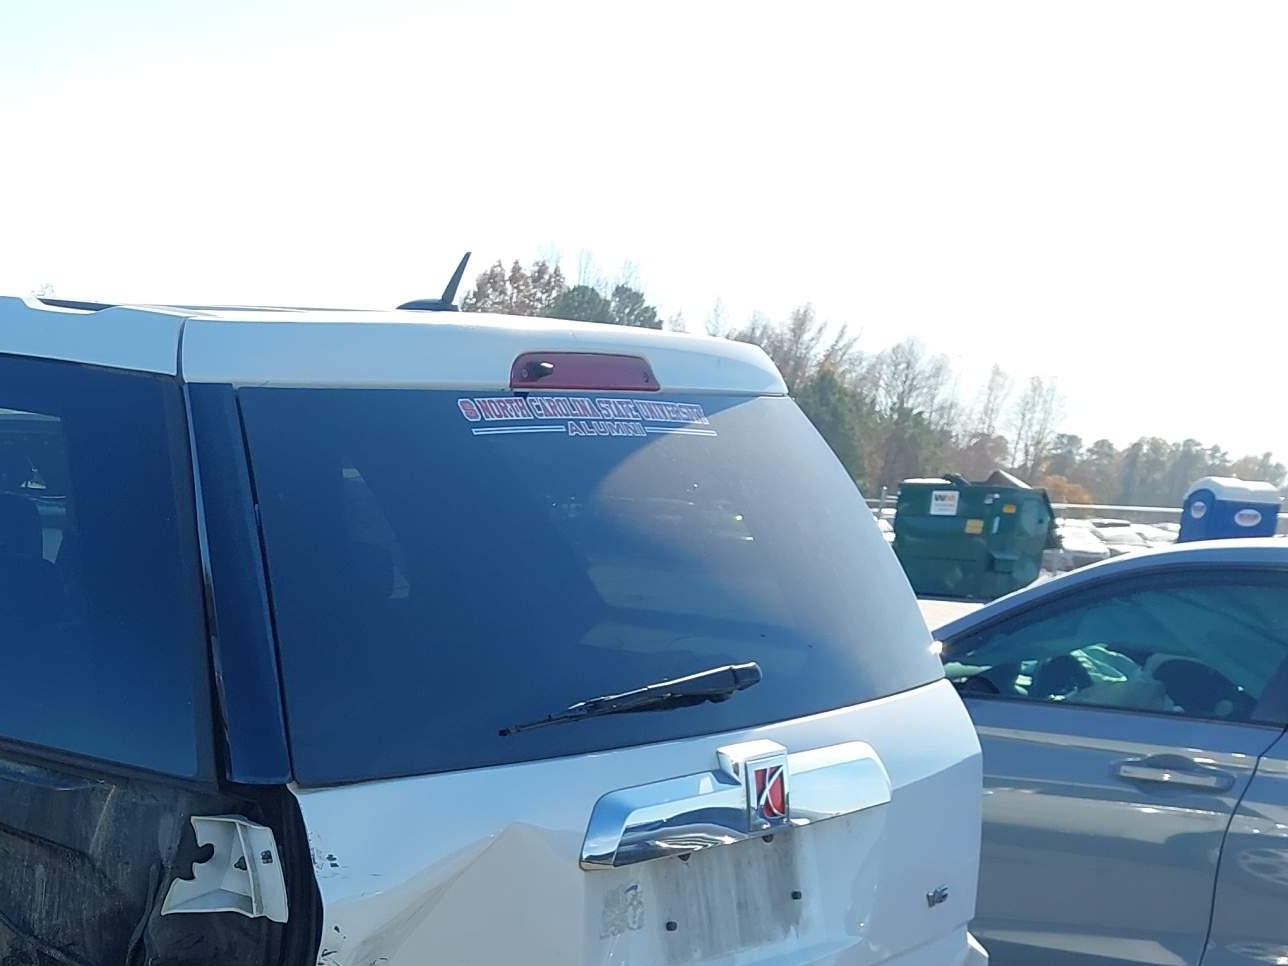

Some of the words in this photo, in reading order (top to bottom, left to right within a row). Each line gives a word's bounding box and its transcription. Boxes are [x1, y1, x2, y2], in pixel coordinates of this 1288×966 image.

[474, 397, 534, 420] NORTH
[526, 397, 603, 419] CAROLINA
[596, 398, 642, 420] STATE
[568, 421, 647, 436] ALUMNI
[926, 887, 948, 908] V6
